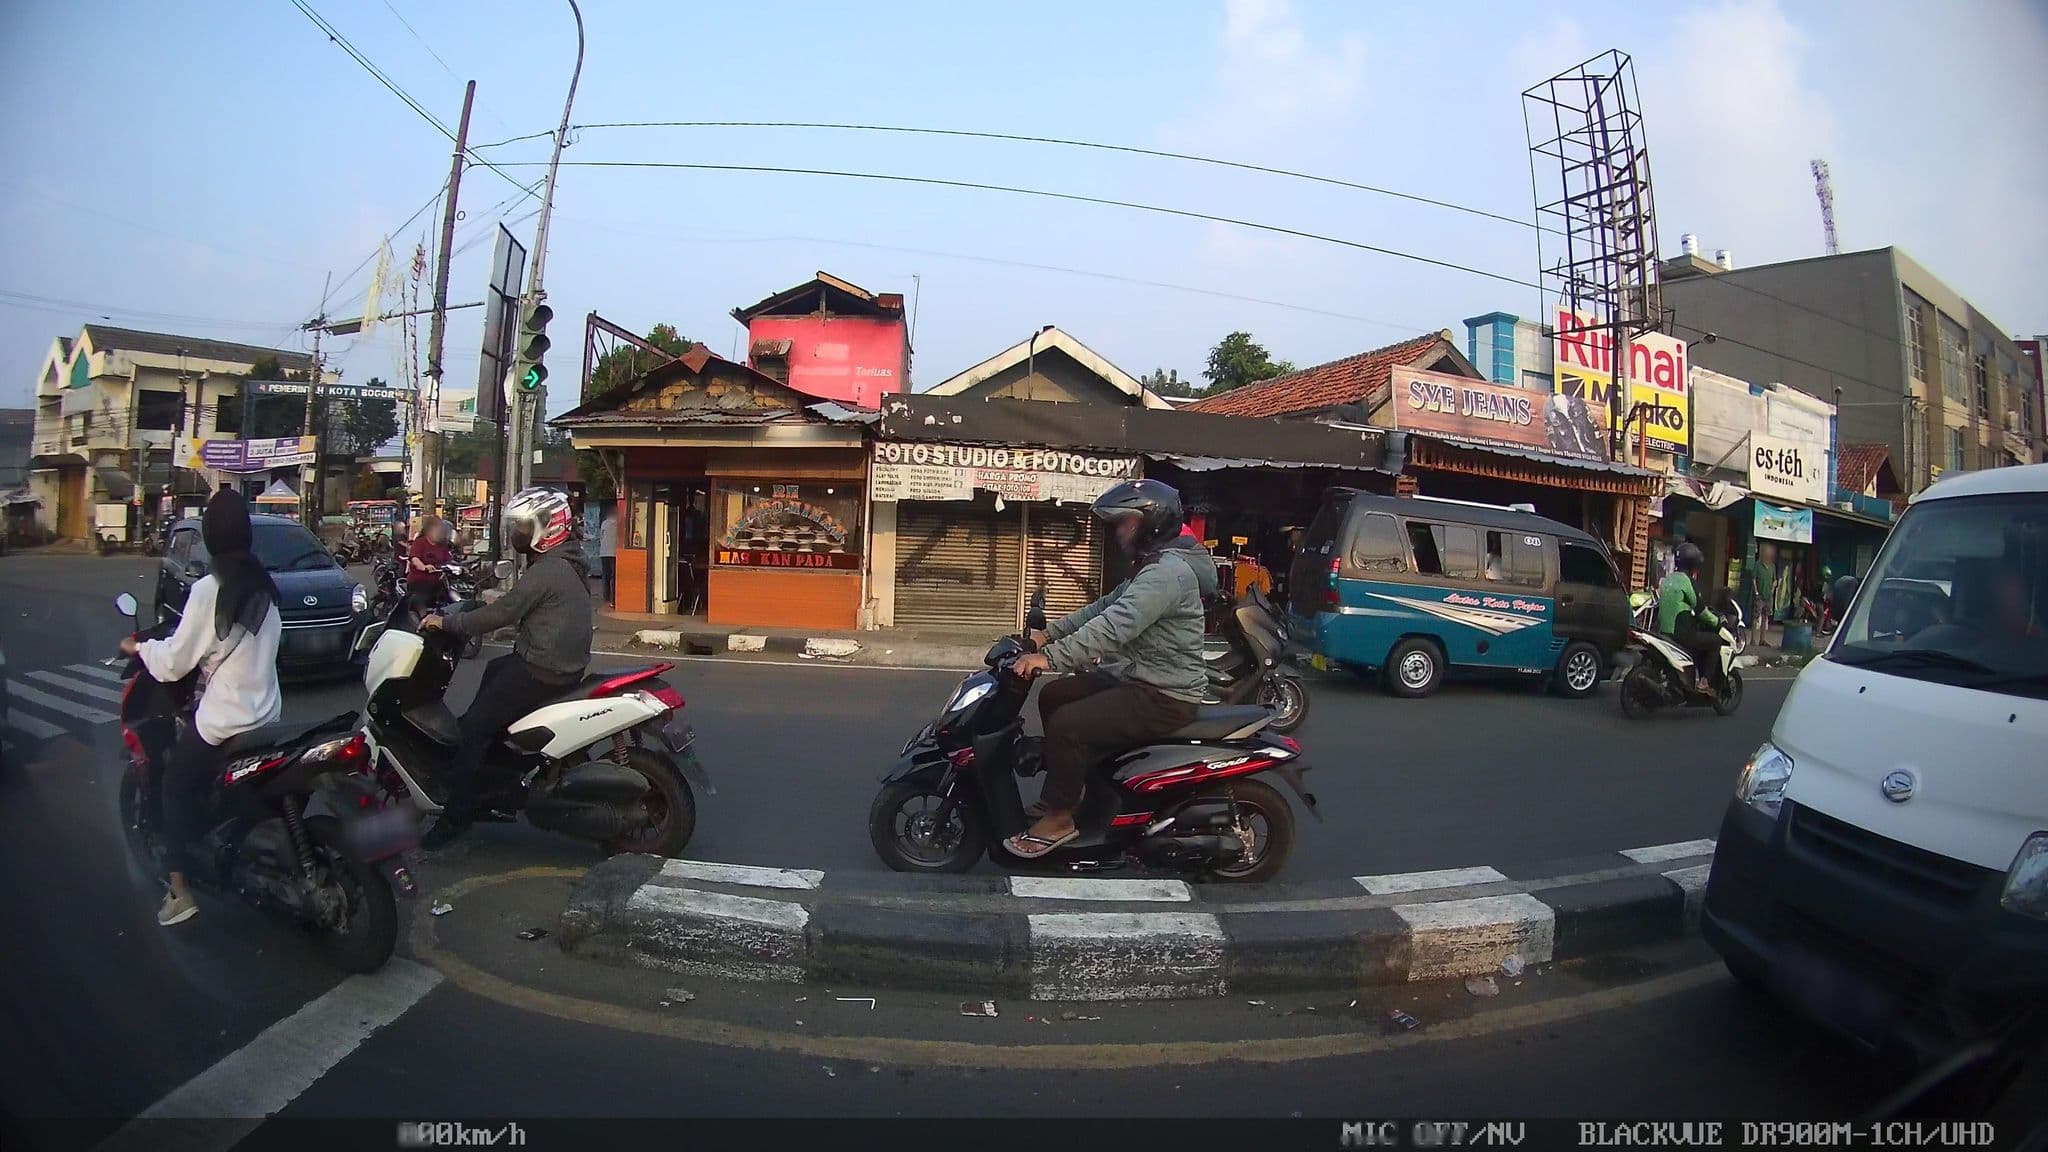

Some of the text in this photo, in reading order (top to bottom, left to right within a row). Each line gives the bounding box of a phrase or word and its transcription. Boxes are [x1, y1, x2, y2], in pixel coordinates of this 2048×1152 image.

[268, 384, 395, 399] PEMERINTH KOTA BOGOR
[1408, 380, 1532, 427] SYE JEANS
[875, 442, 1137, 477] FOTO STUDIO & FOTOCOPY
[978, 471, 1037, 483] HARGA PROMO
[1764, 473, 1794, 486] INDONESIA
[795, 554, 833, 568] PADA
[1443, 593, 1480, 605] Lintas
[1482, 597, 1510, 608] Kota
[1206, 757, 1250, 770] Genio
